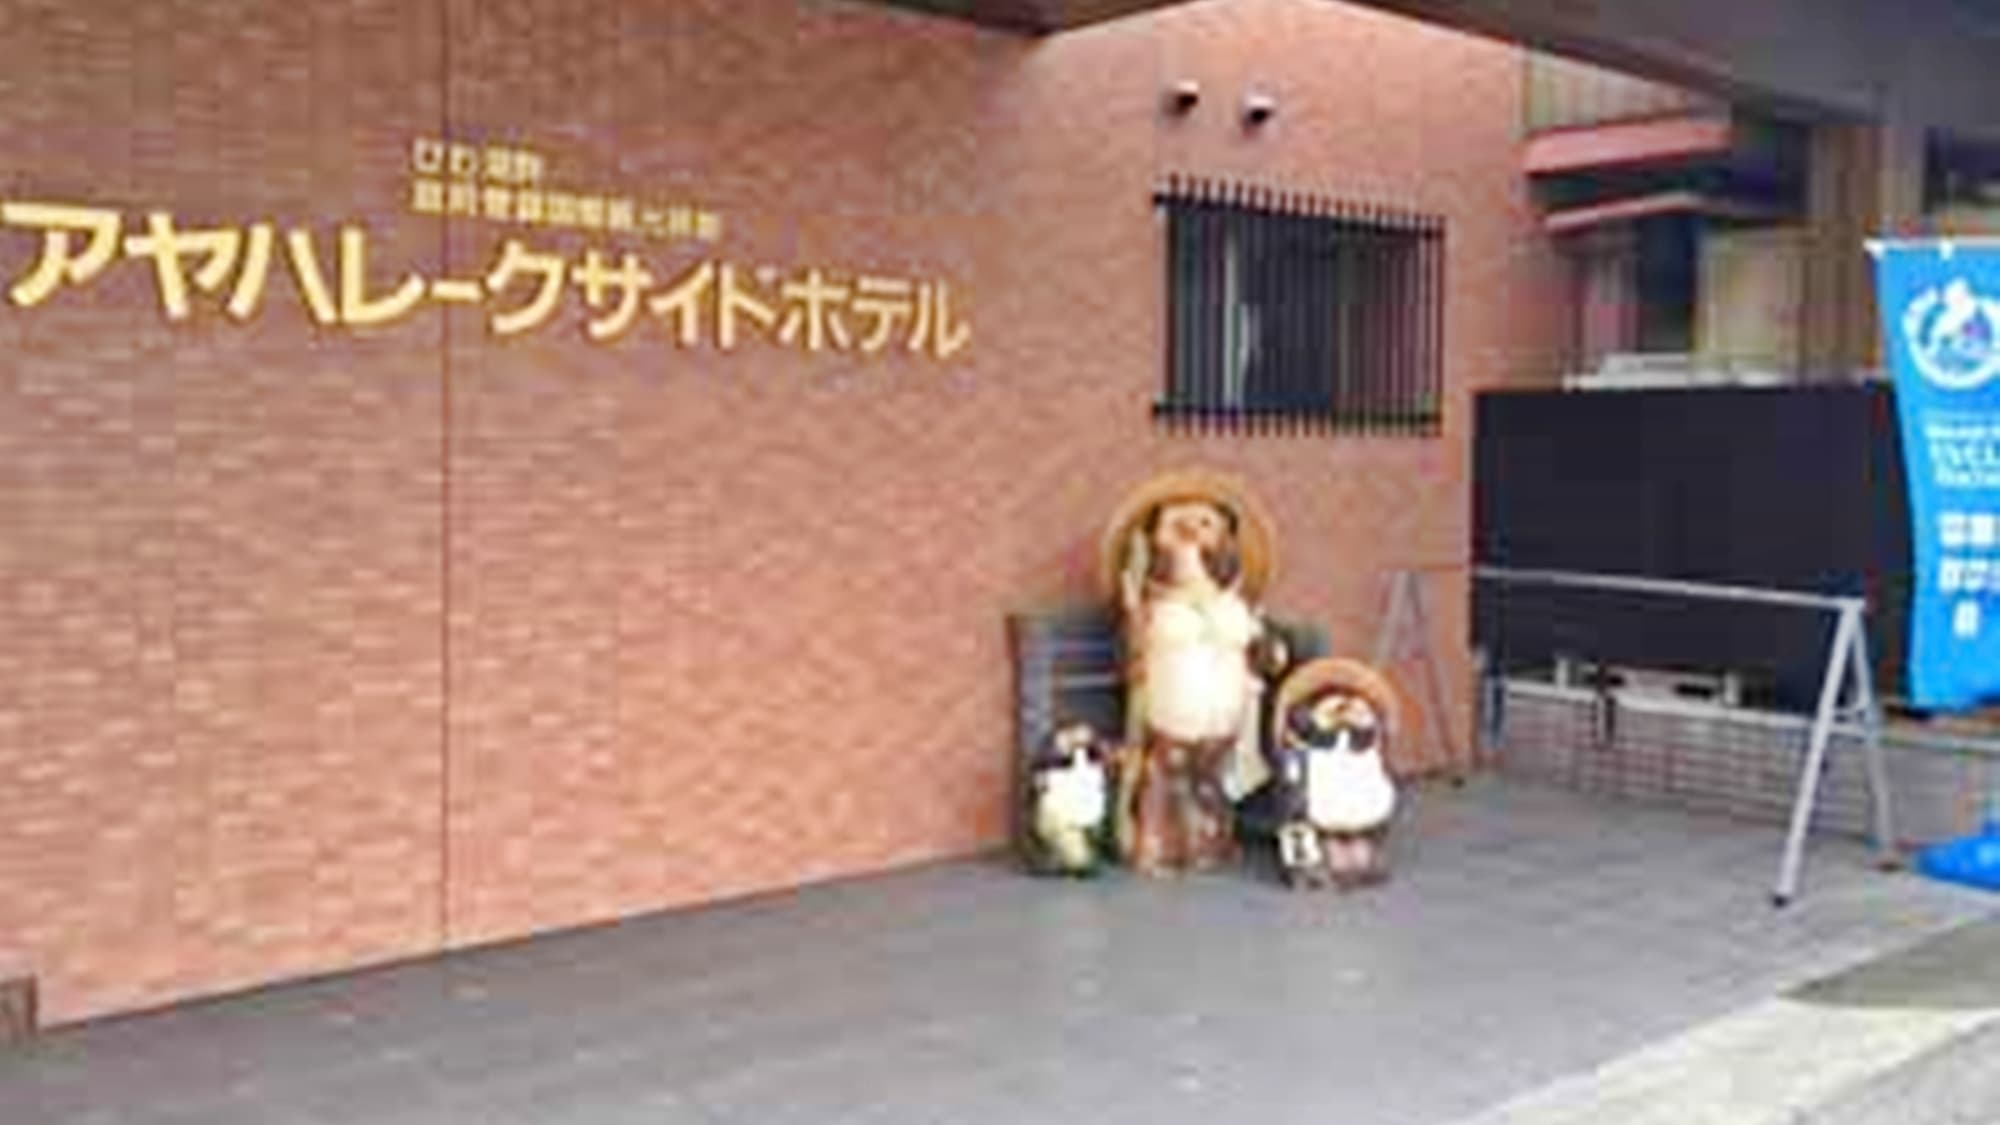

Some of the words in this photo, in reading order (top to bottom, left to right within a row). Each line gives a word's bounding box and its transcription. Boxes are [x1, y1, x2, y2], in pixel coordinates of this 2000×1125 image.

[2, 202, 971, 360] アヤハレークサイドホテル
